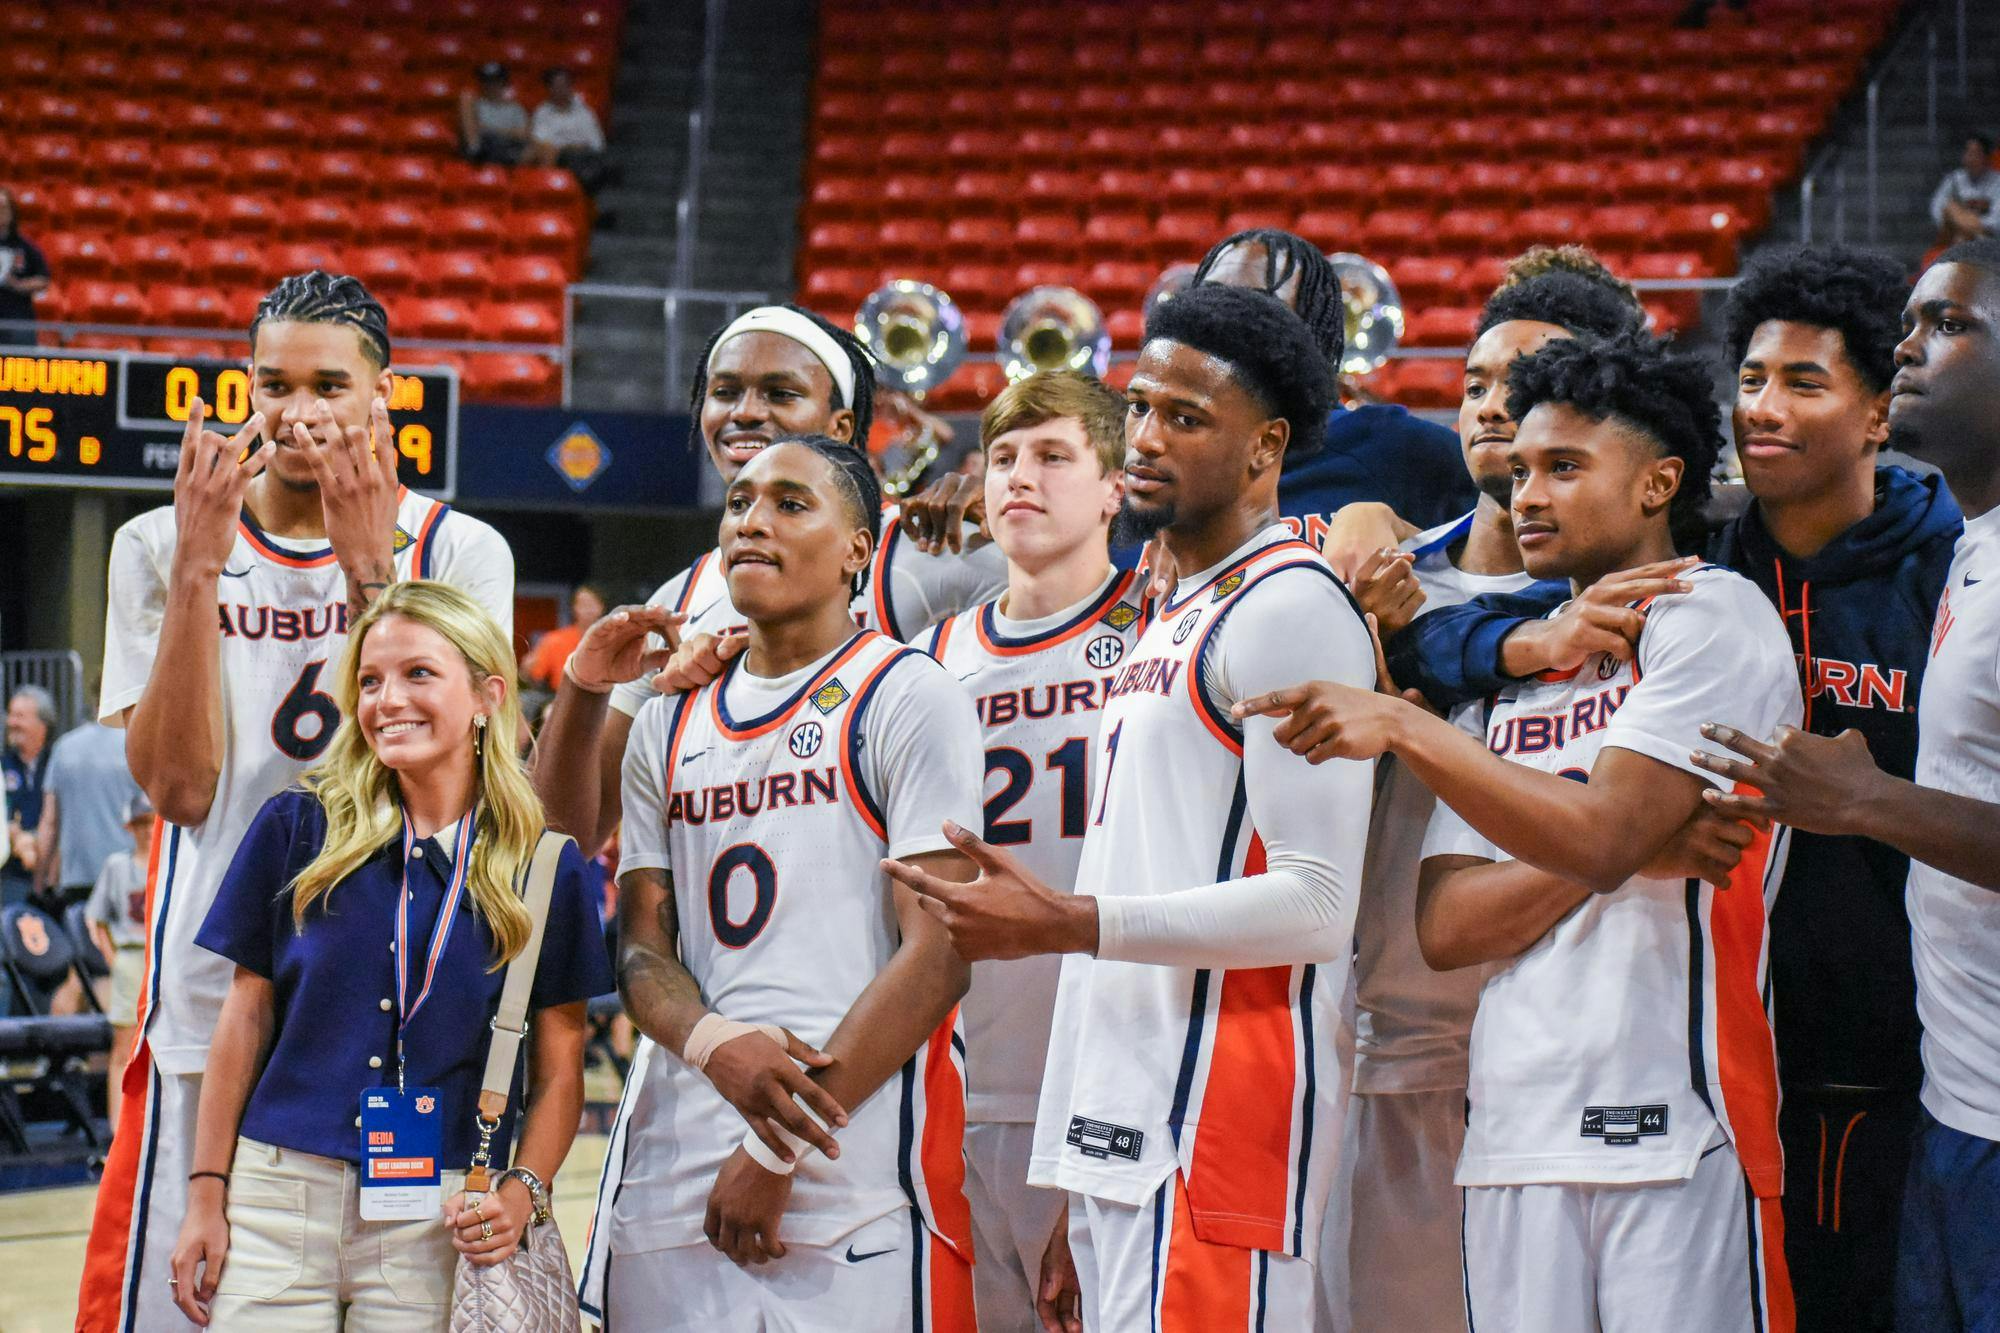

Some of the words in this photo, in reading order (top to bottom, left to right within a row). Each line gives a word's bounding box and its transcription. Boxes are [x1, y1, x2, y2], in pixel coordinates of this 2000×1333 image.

[165, 367, 249, 423] 0.0
[0, 406, 56, 462] 75
[1087, 637, 1123, 668] SEC
[271, 657, 343, 762] 6
[789, 721, 823, 759] SEC
[669, 766, 840, 828] AUBURN
[983, 736, 1090, 846] 21
[708, 841, 778, 951] 0
[368, 1131, 394, 1145] MEDIA
[1115, 1135, 1130, 1149] 48
[1643, 1113, 1660, 1126] 44
